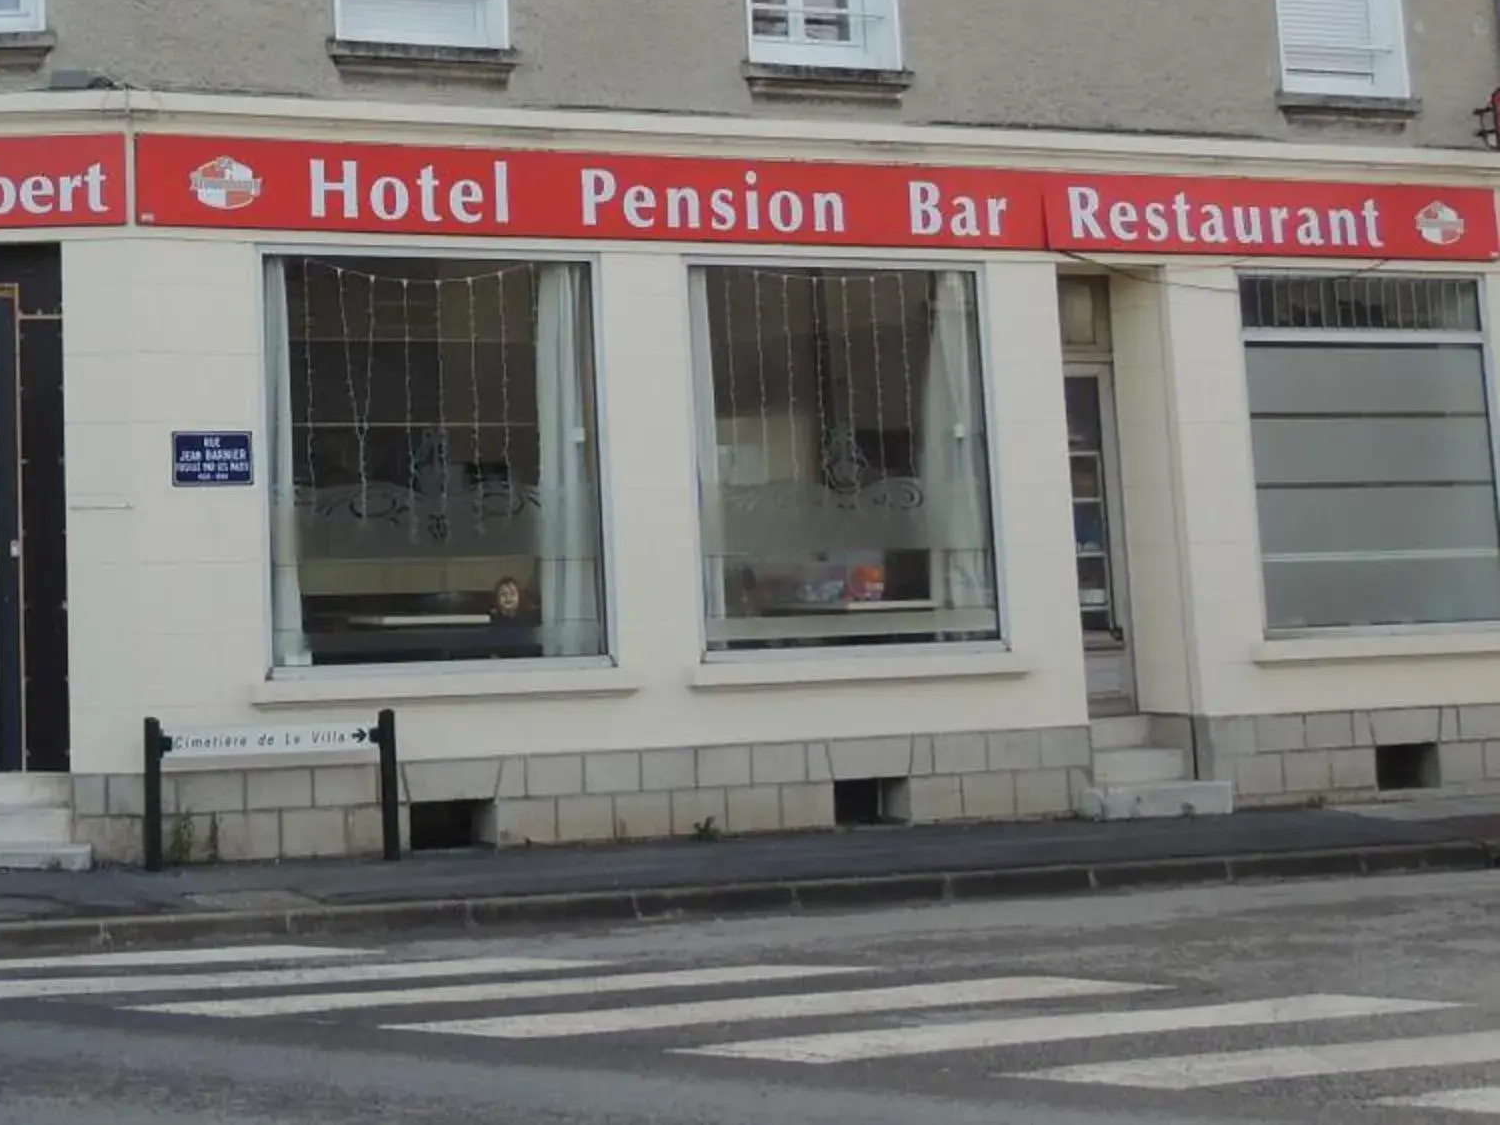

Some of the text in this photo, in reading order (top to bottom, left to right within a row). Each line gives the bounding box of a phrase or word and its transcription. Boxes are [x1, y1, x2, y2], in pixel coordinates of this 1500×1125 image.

[310, 159, 1385, 248] Hotel Pension Bar Restaurant
